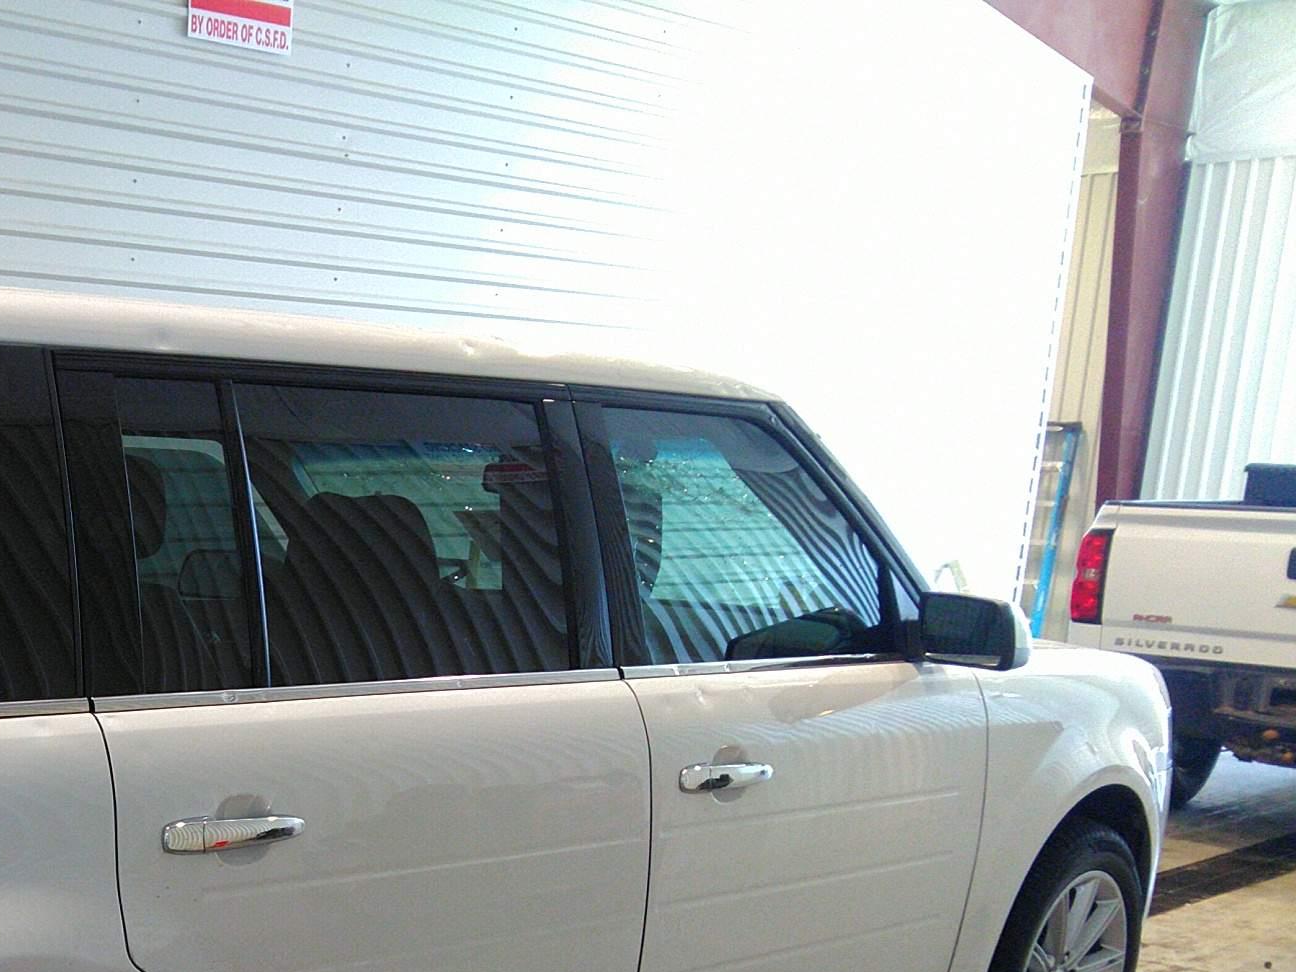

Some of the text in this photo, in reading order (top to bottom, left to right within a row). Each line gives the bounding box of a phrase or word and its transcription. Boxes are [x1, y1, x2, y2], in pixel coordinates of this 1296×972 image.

[191, 14, 289, 50] BY ORDER OF C.S.F.D.
[1114, 637, 1224, 655] SILVERADO
